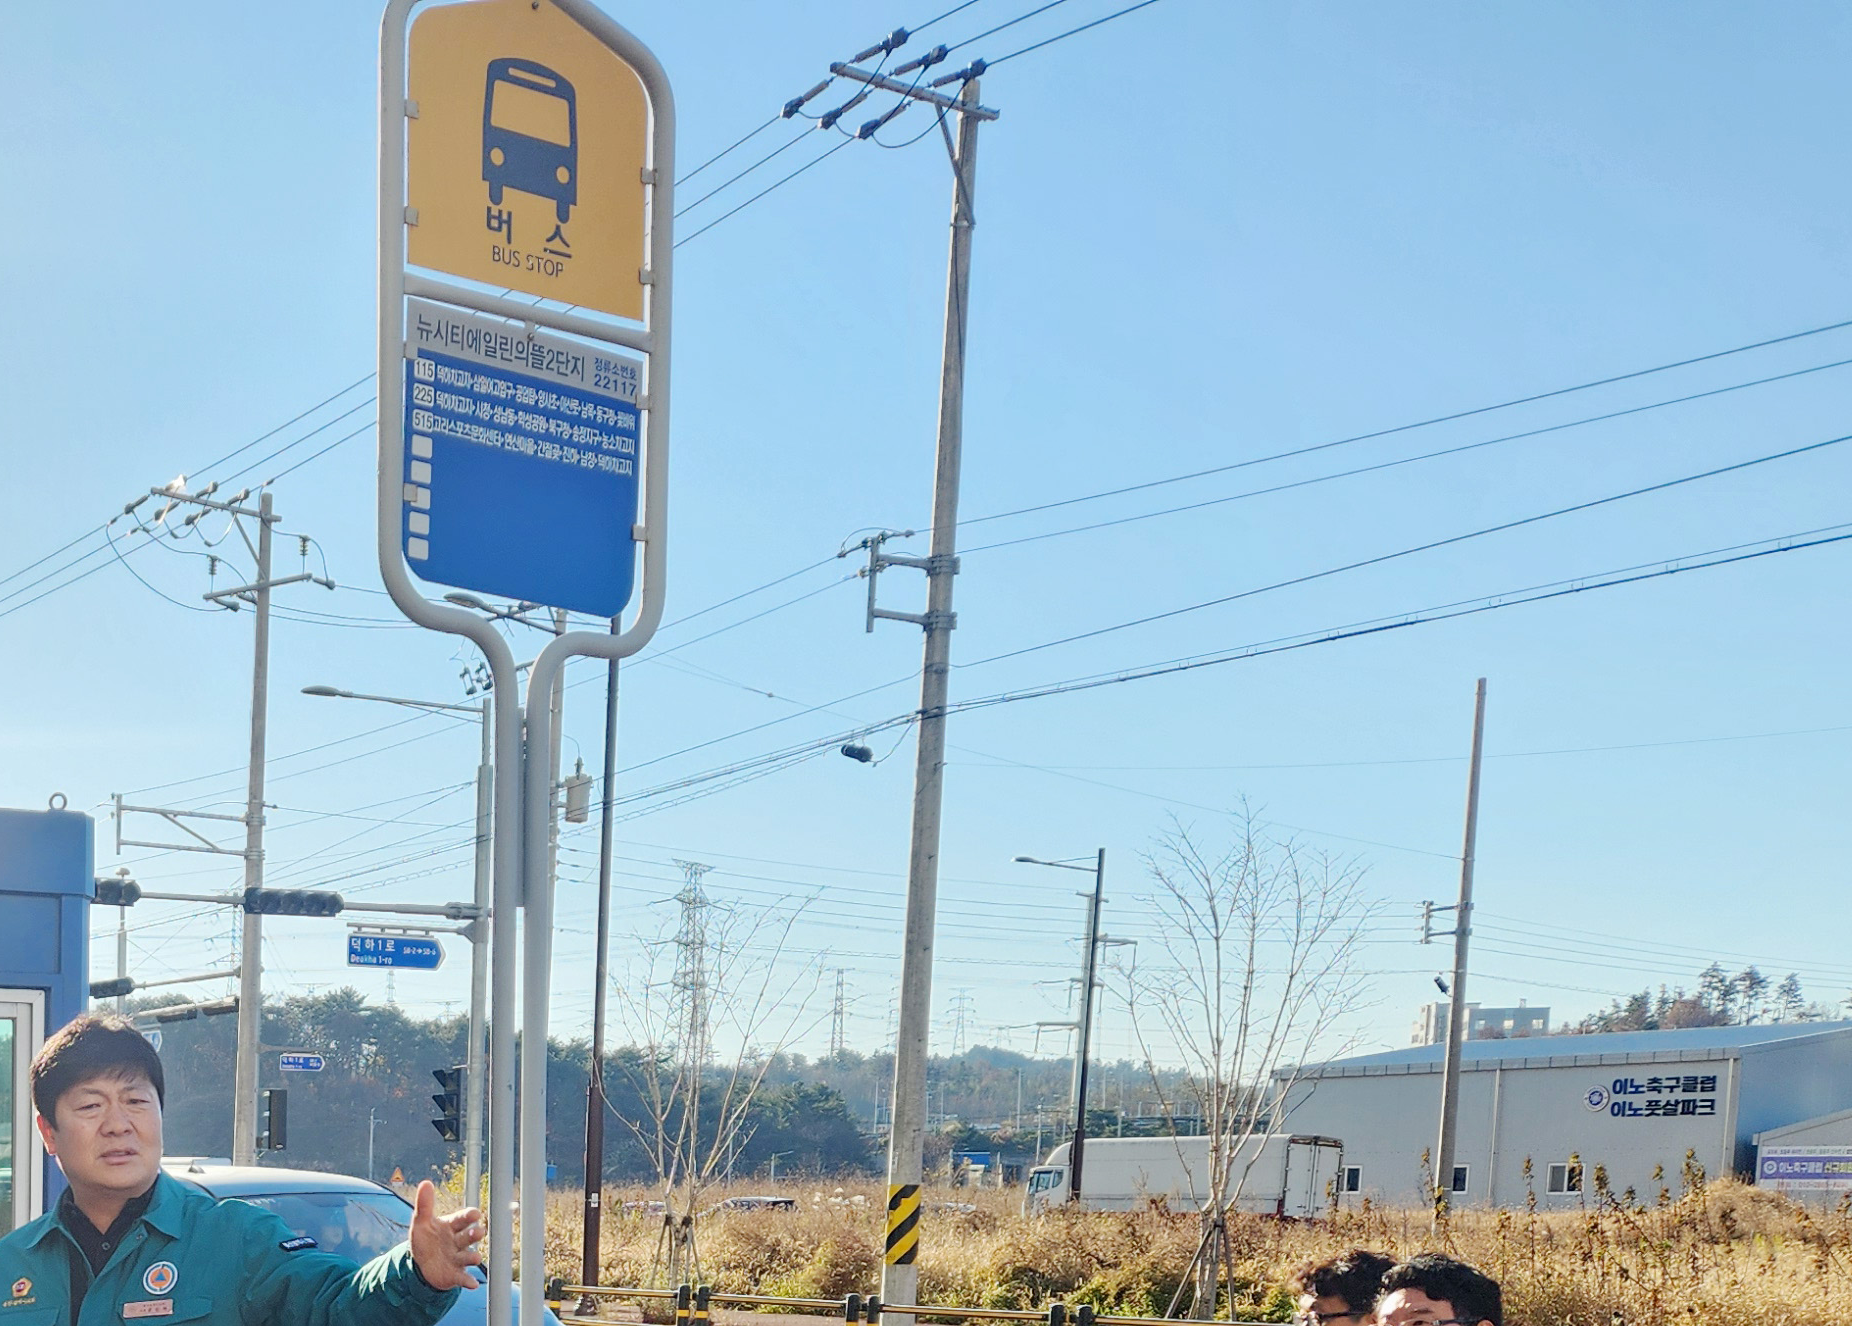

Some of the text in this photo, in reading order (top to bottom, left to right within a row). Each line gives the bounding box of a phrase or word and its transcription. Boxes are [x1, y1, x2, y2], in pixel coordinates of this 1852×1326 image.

[486, 206, 572, 258] 버스
[492, 245, 564, 277] BUS STOP
[417, 313, 585, 382] 뉴시티에일린의뜰2단지
[416, 359, 433, 378] 115
[595, 357, 637, 381] 정류소번호
[415, 385, 433, 404] 225
[594, 373, 637, 397] 22117
[415, 411, 432, 429] 515
[1612, 1075, 1717, 1095] 이노축구클럽
[1610, 1098, 1717, 1118] 이노풋살파크
